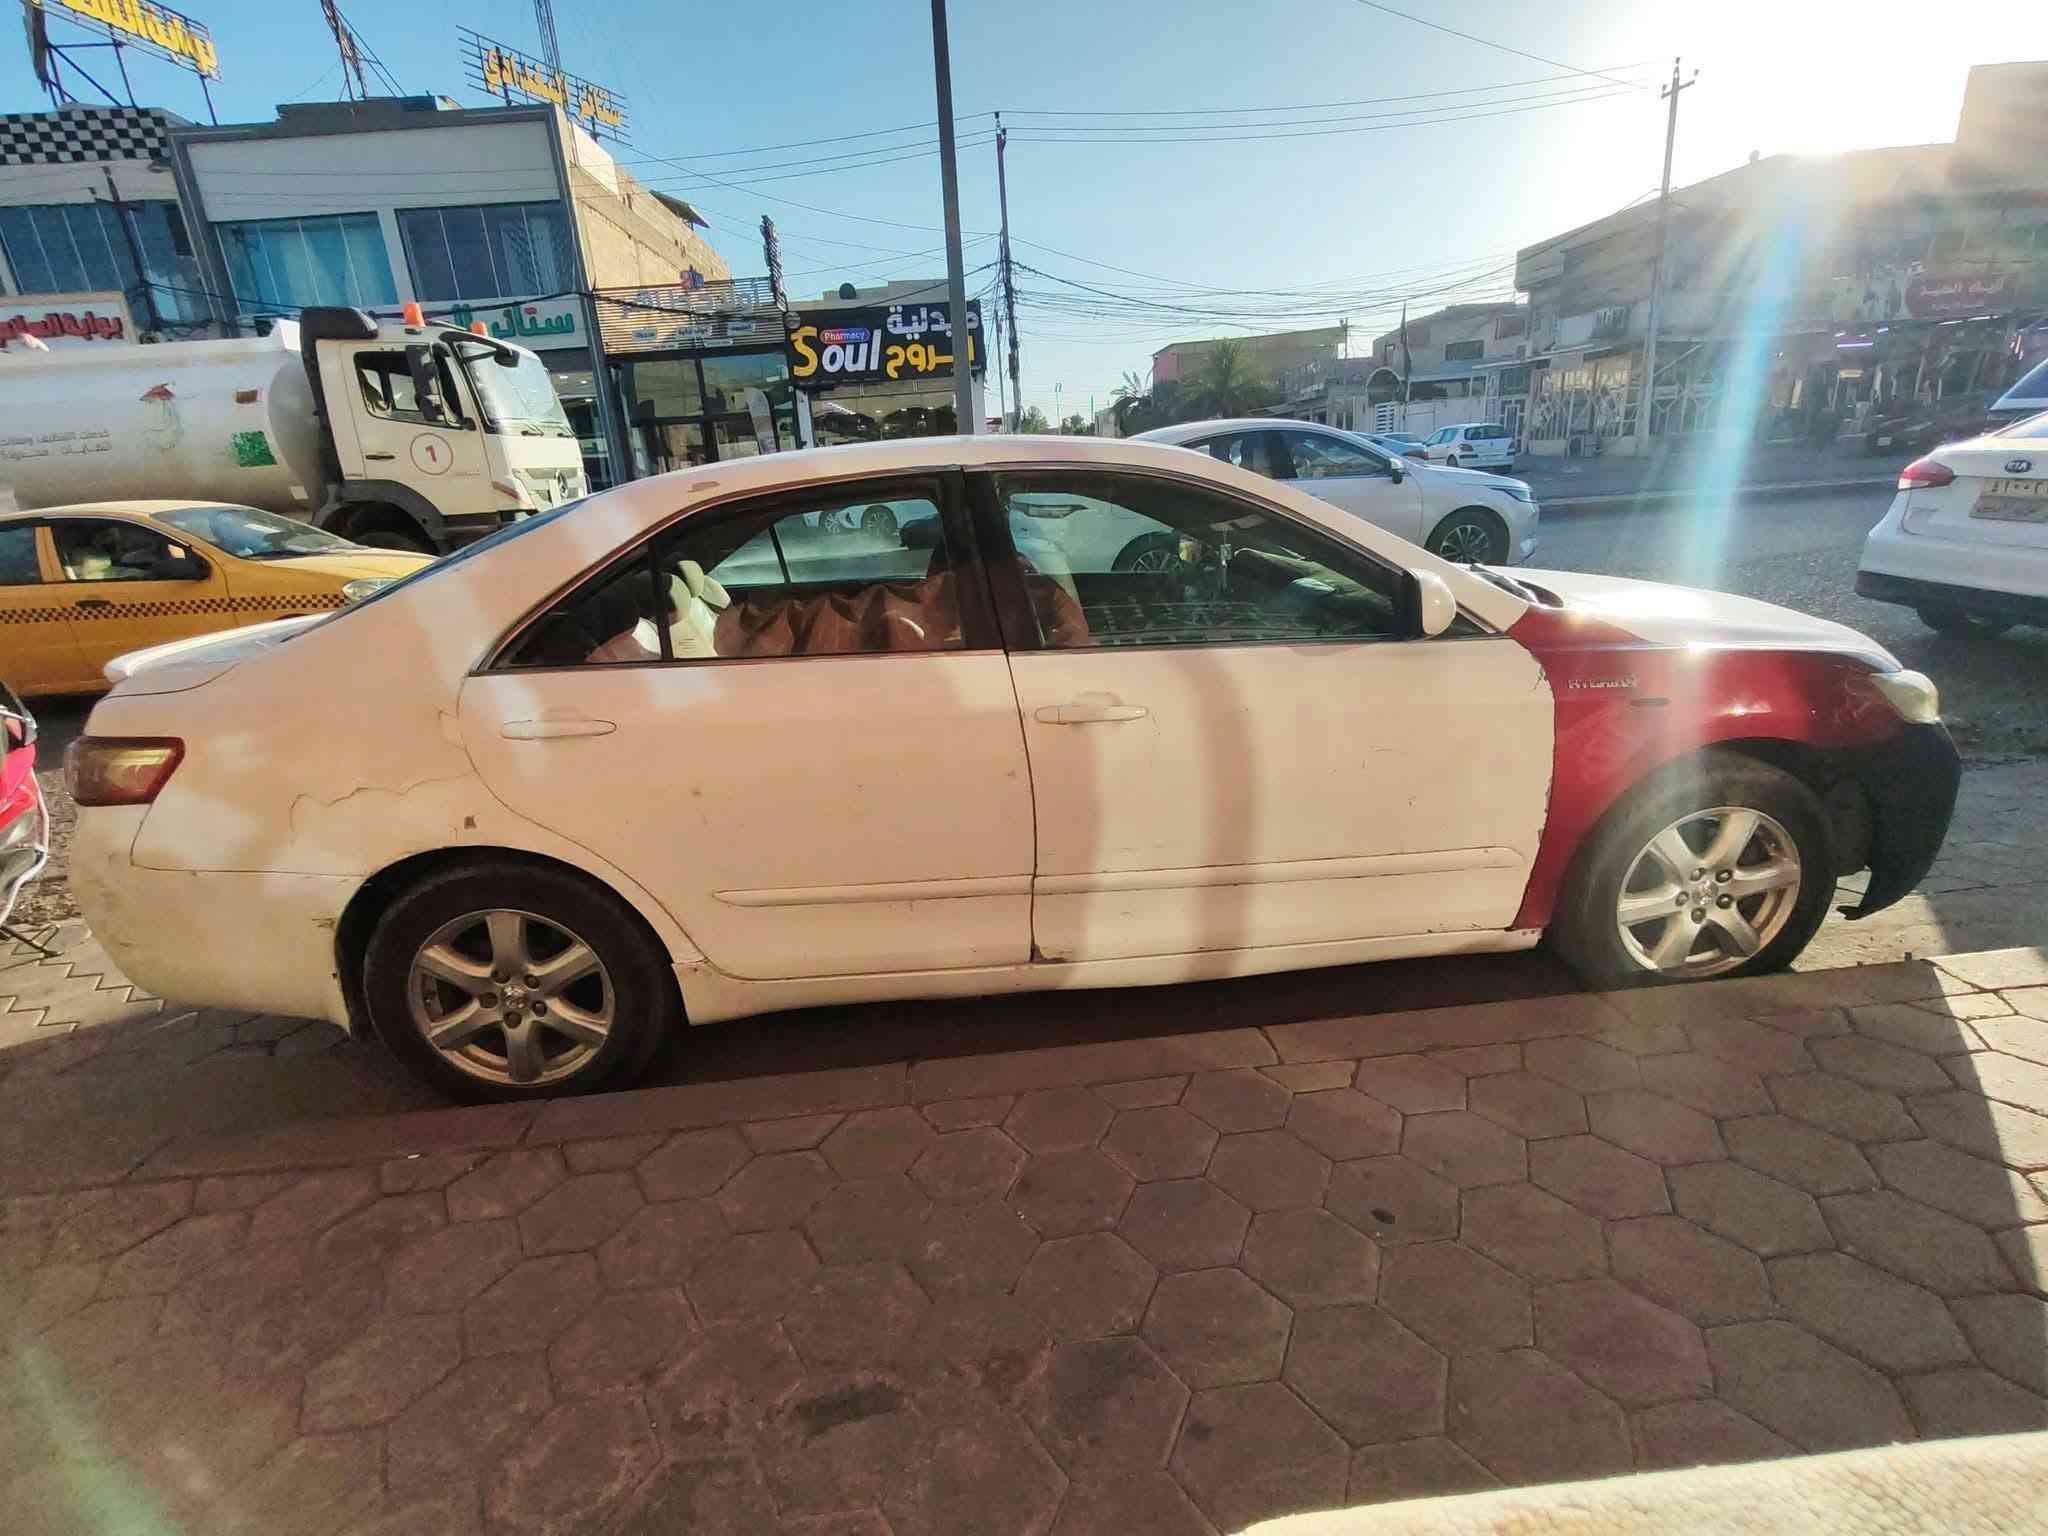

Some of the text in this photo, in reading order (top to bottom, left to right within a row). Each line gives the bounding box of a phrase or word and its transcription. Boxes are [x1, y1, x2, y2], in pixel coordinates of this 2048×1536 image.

[791, 326, 883, 377] Soul
[823, 331, 869, 343] Pharmacy
[885, 335, 976, 379] اروح
[425, 445, 437, 464] 1
